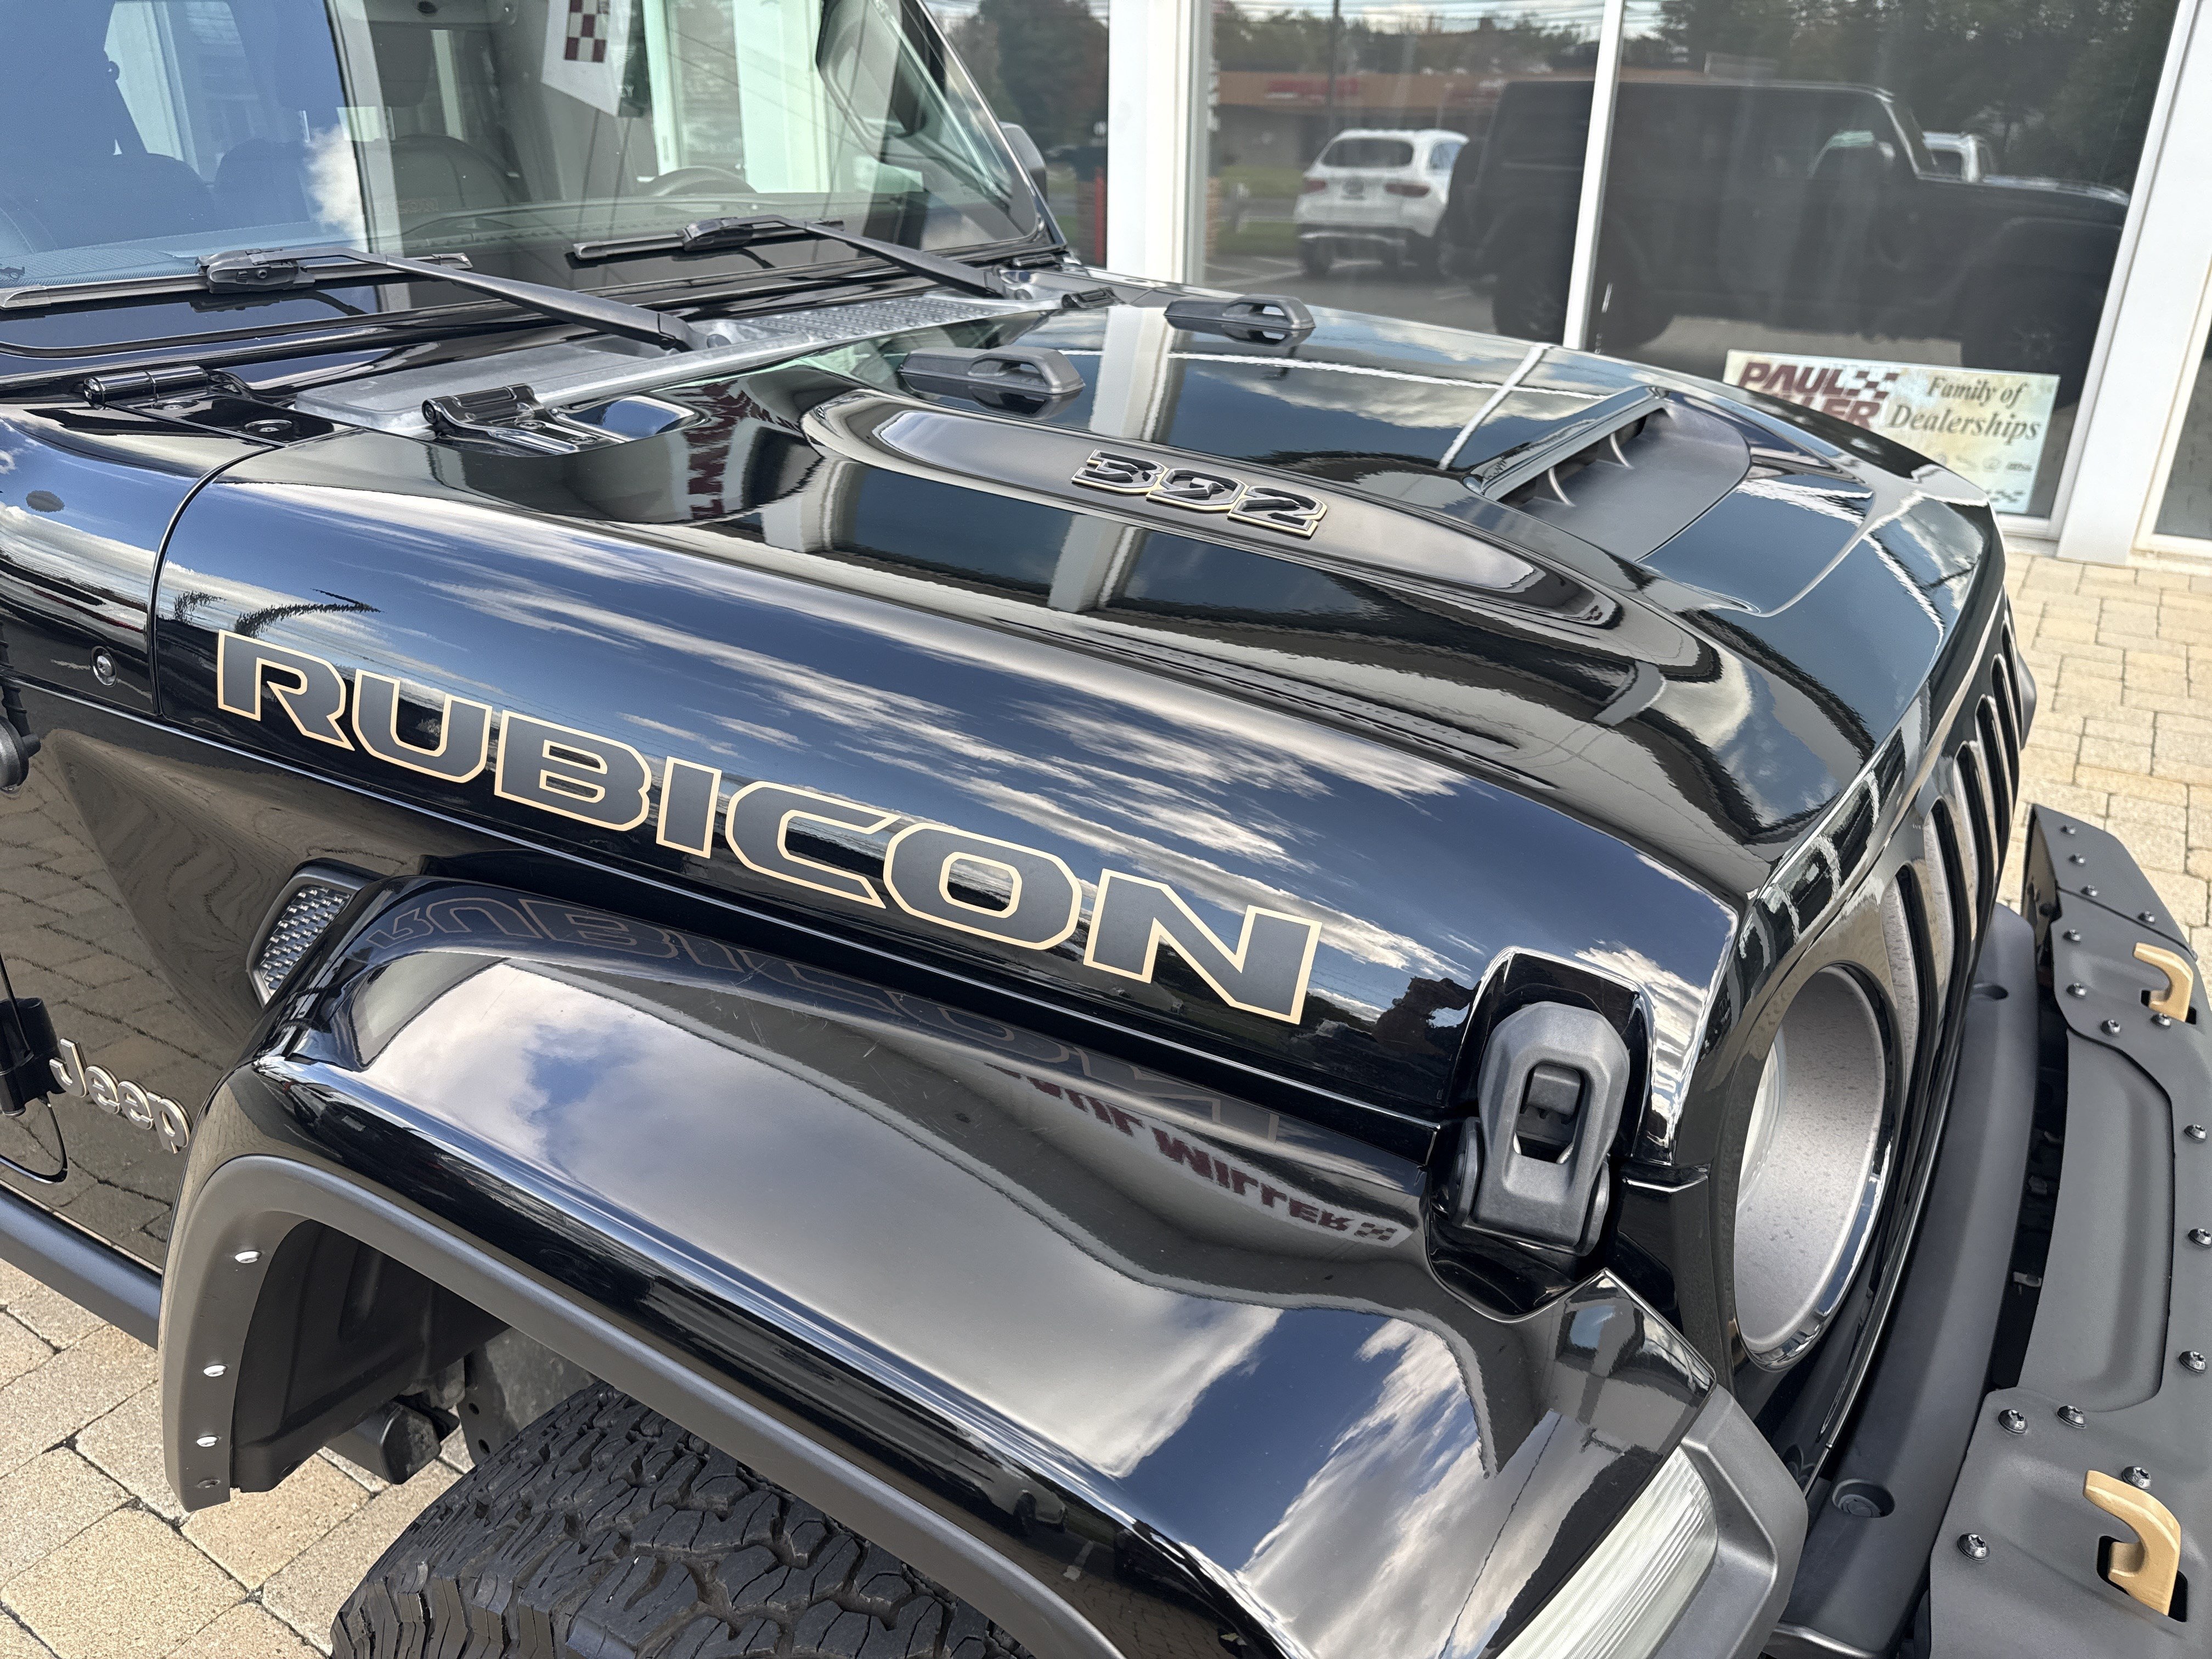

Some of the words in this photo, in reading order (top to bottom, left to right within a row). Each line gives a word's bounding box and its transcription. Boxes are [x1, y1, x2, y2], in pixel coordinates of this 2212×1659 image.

[1737, 362, 1844, 394] PAUL
[1926, 375, 1998, 407] Family
[1999, 382, 2028, 410] of
[1889, 403, 2042, 446] Dealerships
[1070, 449, 1328, 539] 392
[216, 630, 1321, 1025] RUBICON
[49, 1038, 191, 1154] Jeep
